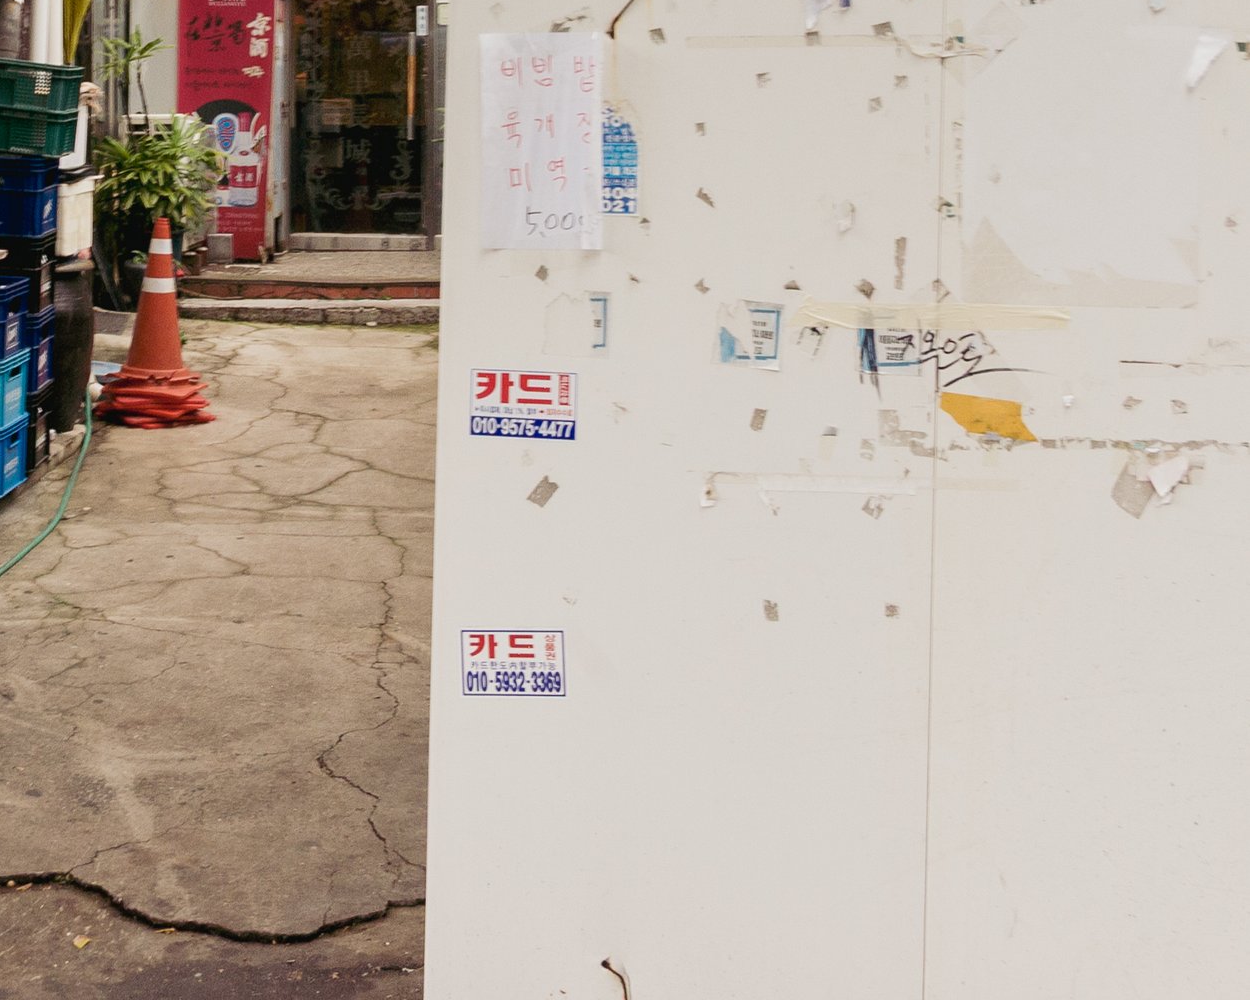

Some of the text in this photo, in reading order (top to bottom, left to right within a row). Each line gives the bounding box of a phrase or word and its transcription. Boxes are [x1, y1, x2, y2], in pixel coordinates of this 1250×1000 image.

[476, 372, 552, 405] 카드
[472, 417, 573, 438] 010-9575-4477
[469, 634, 535, 659] 카드
[466, 671, 561, 693] 010-5932-3369
